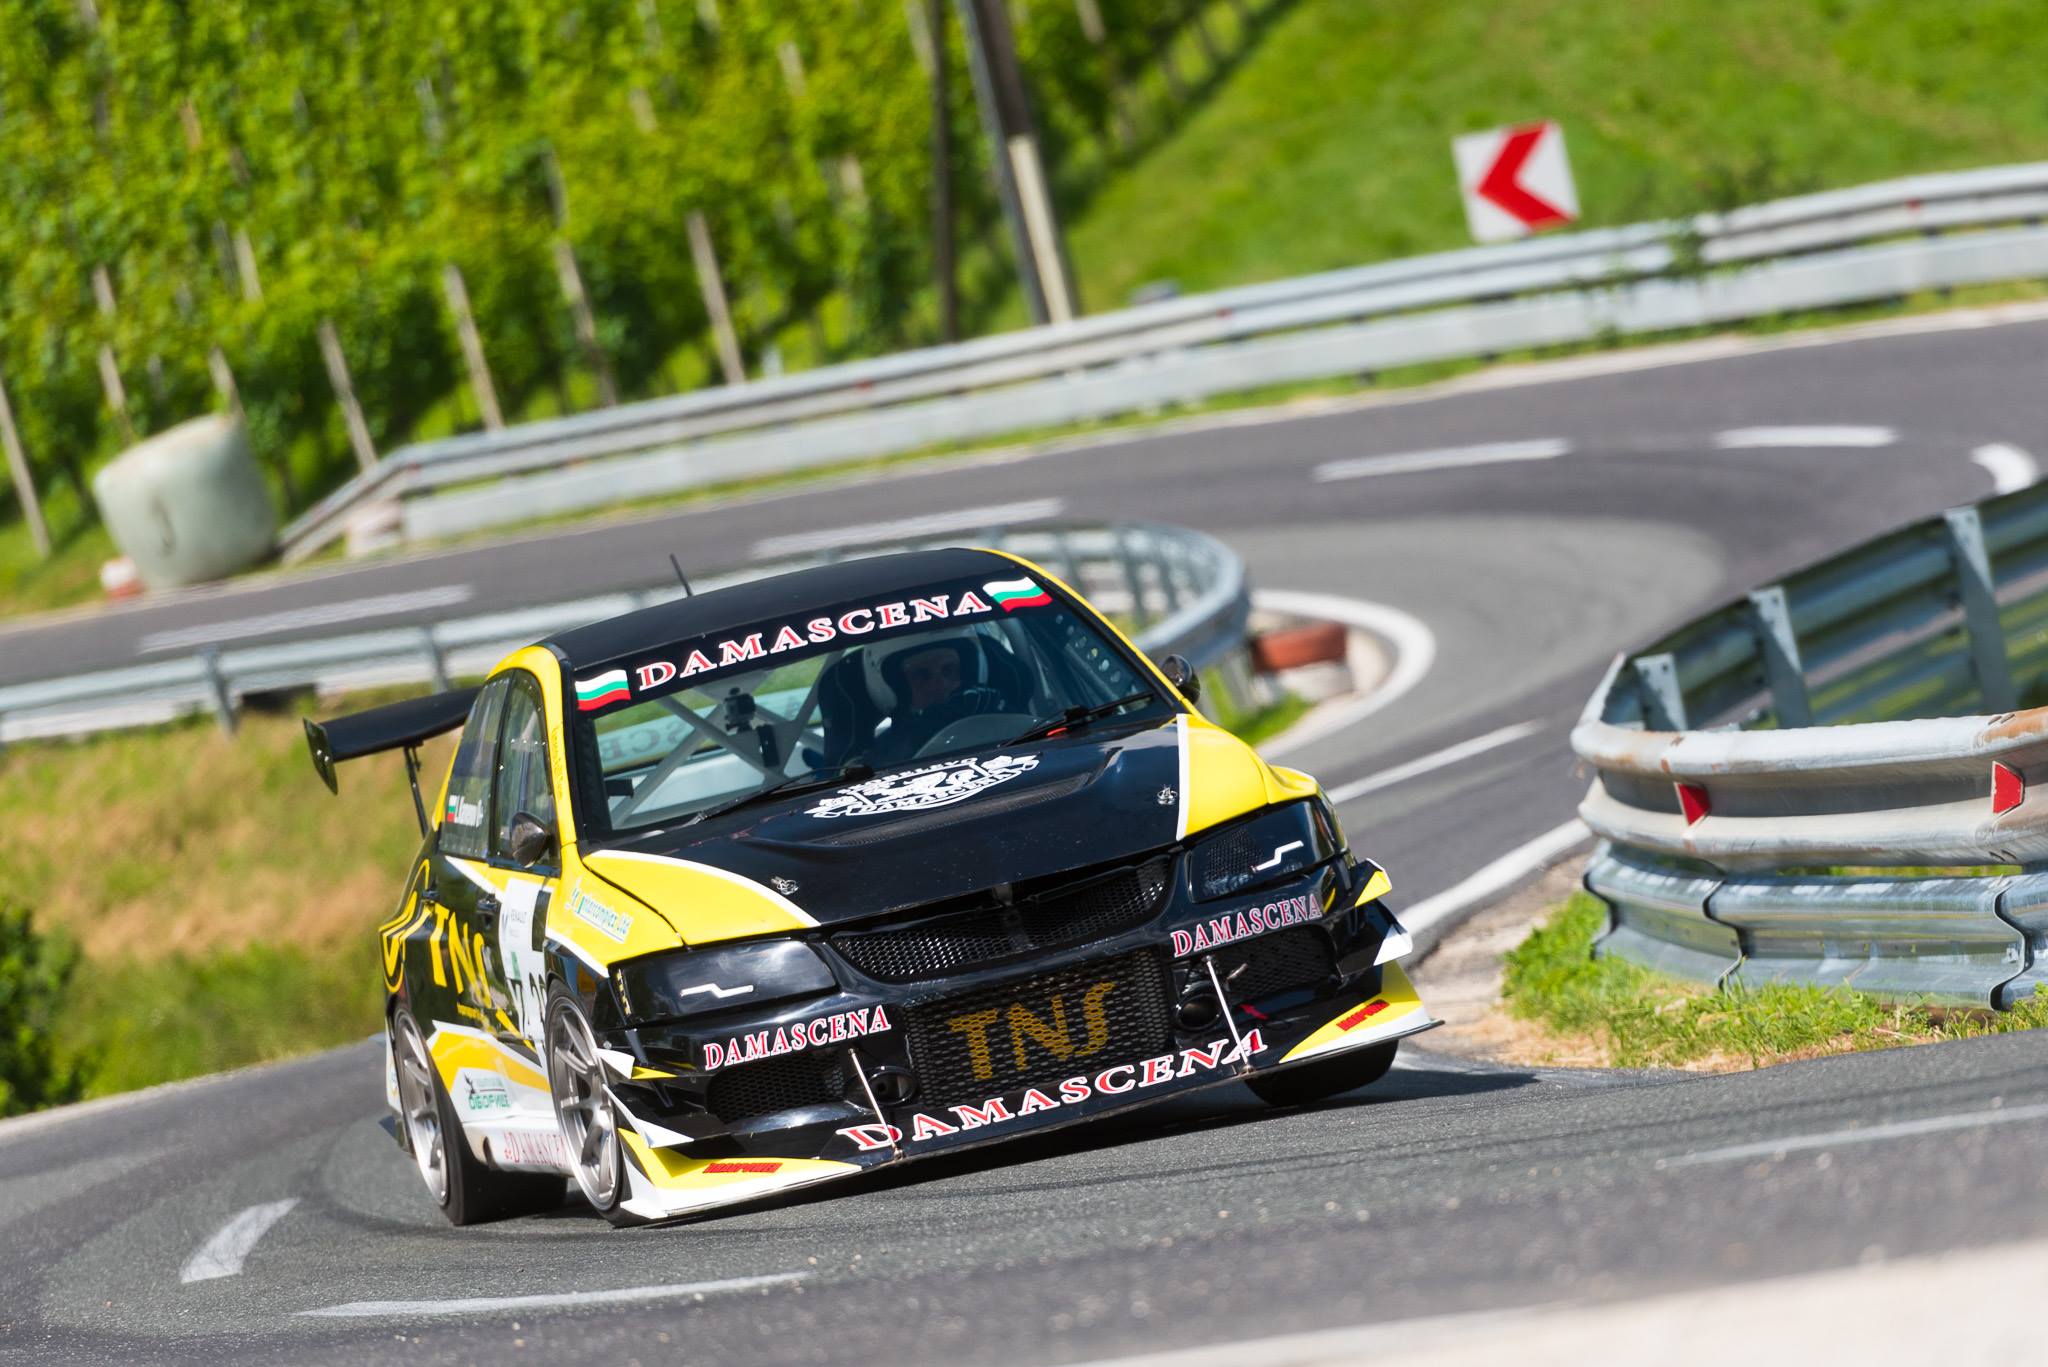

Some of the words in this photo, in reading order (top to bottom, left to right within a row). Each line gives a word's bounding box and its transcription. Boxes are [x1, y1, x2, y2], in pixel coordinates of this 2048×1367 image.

[636, 591, 992, 691] DAMASCENA
[1171, 893, 1322, 958] DAMASCENA
[703, 1005, 892, 1071] DAMASCENA
[947, 981, 1117, 1082] TNS
[836, 1028, 1268, 1151] DAMASCENA
